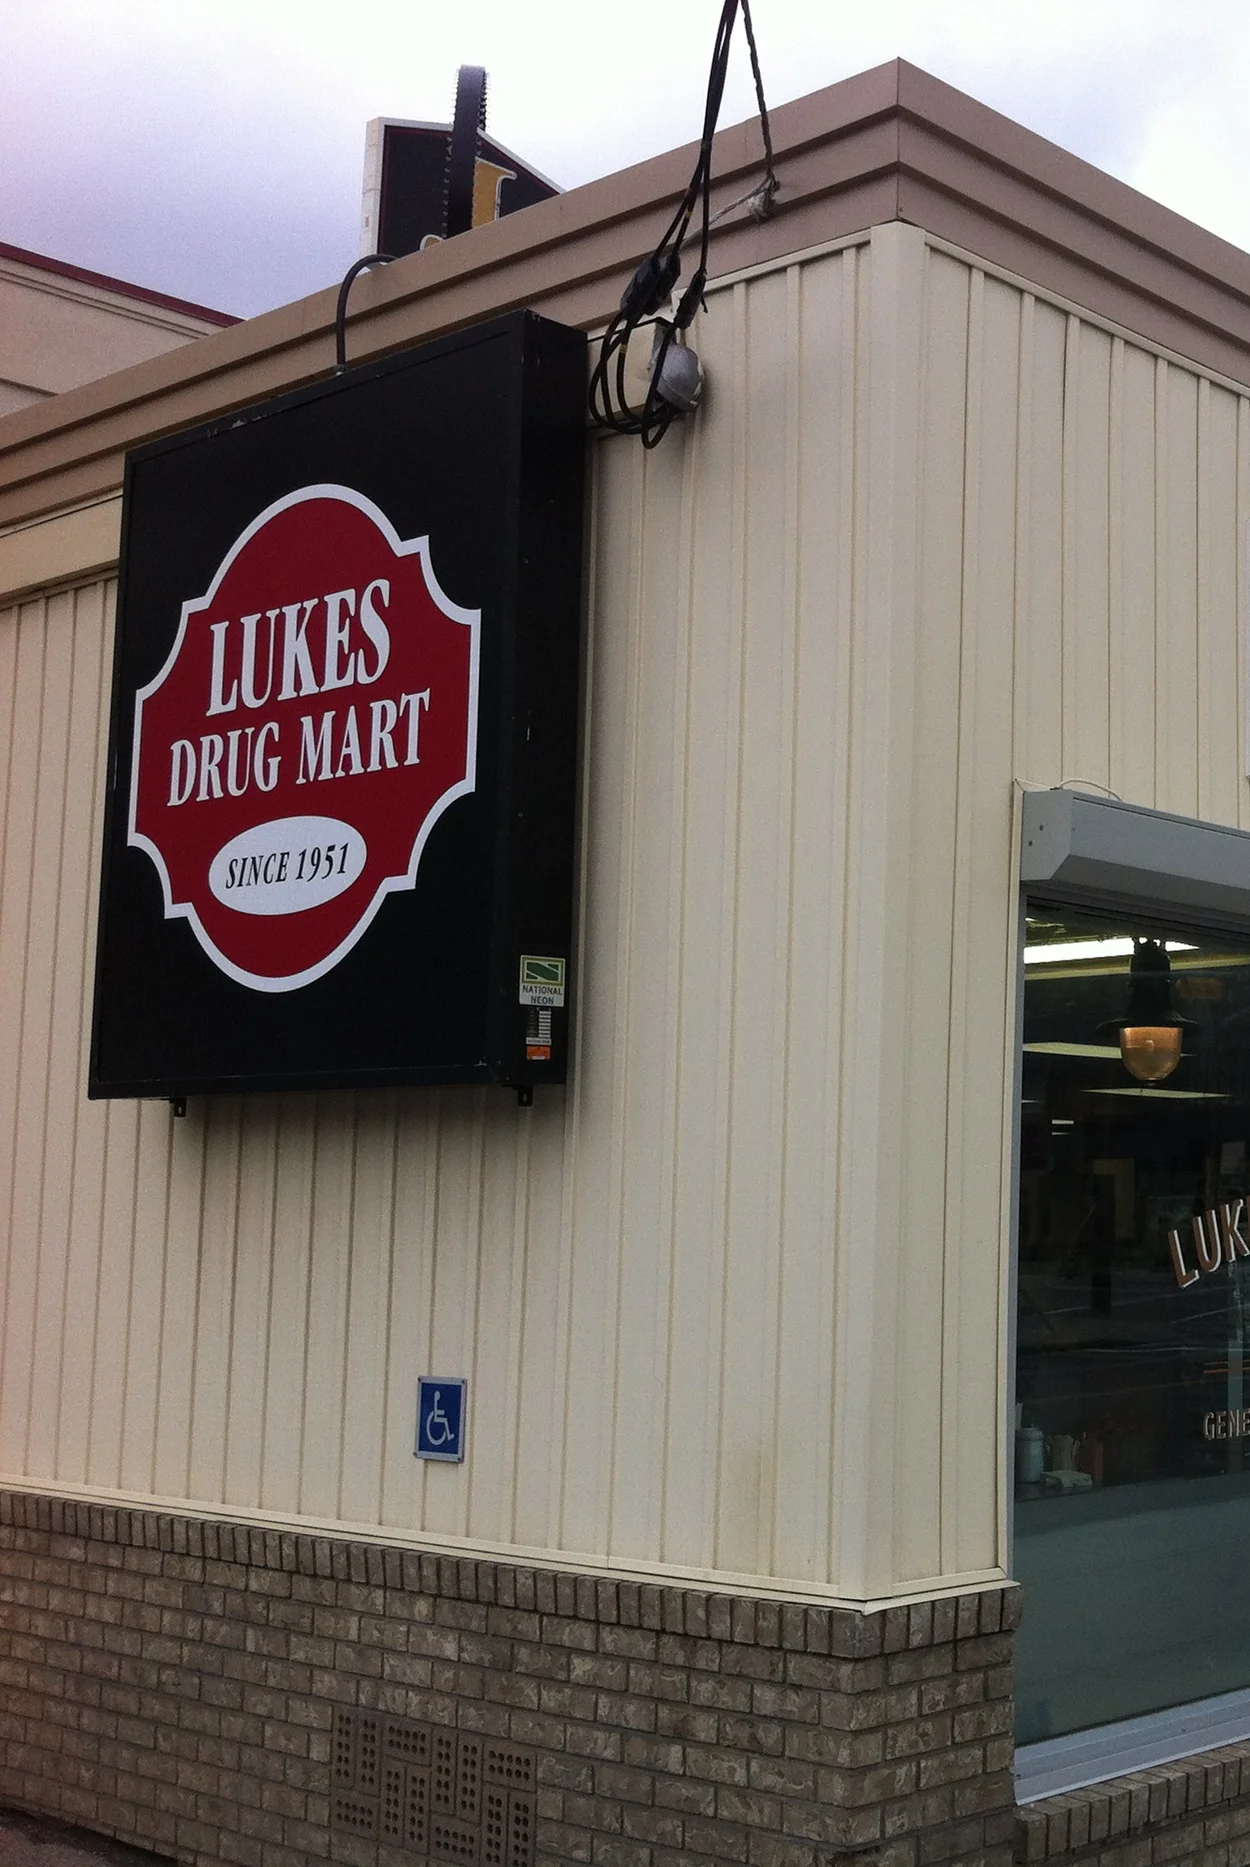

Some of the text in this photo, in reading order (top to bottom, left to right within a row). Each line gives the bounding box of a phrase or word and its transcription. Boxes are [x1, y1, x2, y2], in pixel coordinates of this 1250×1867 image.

[206, 578, 391, 717] LUKES
[167, 687, 432, 808] DRUG MART
[225, 841, 351, 890] SINCE 1951
[522, 984, 563, 996] NATIONAL
[530, 996, 555, 1005] NEON
